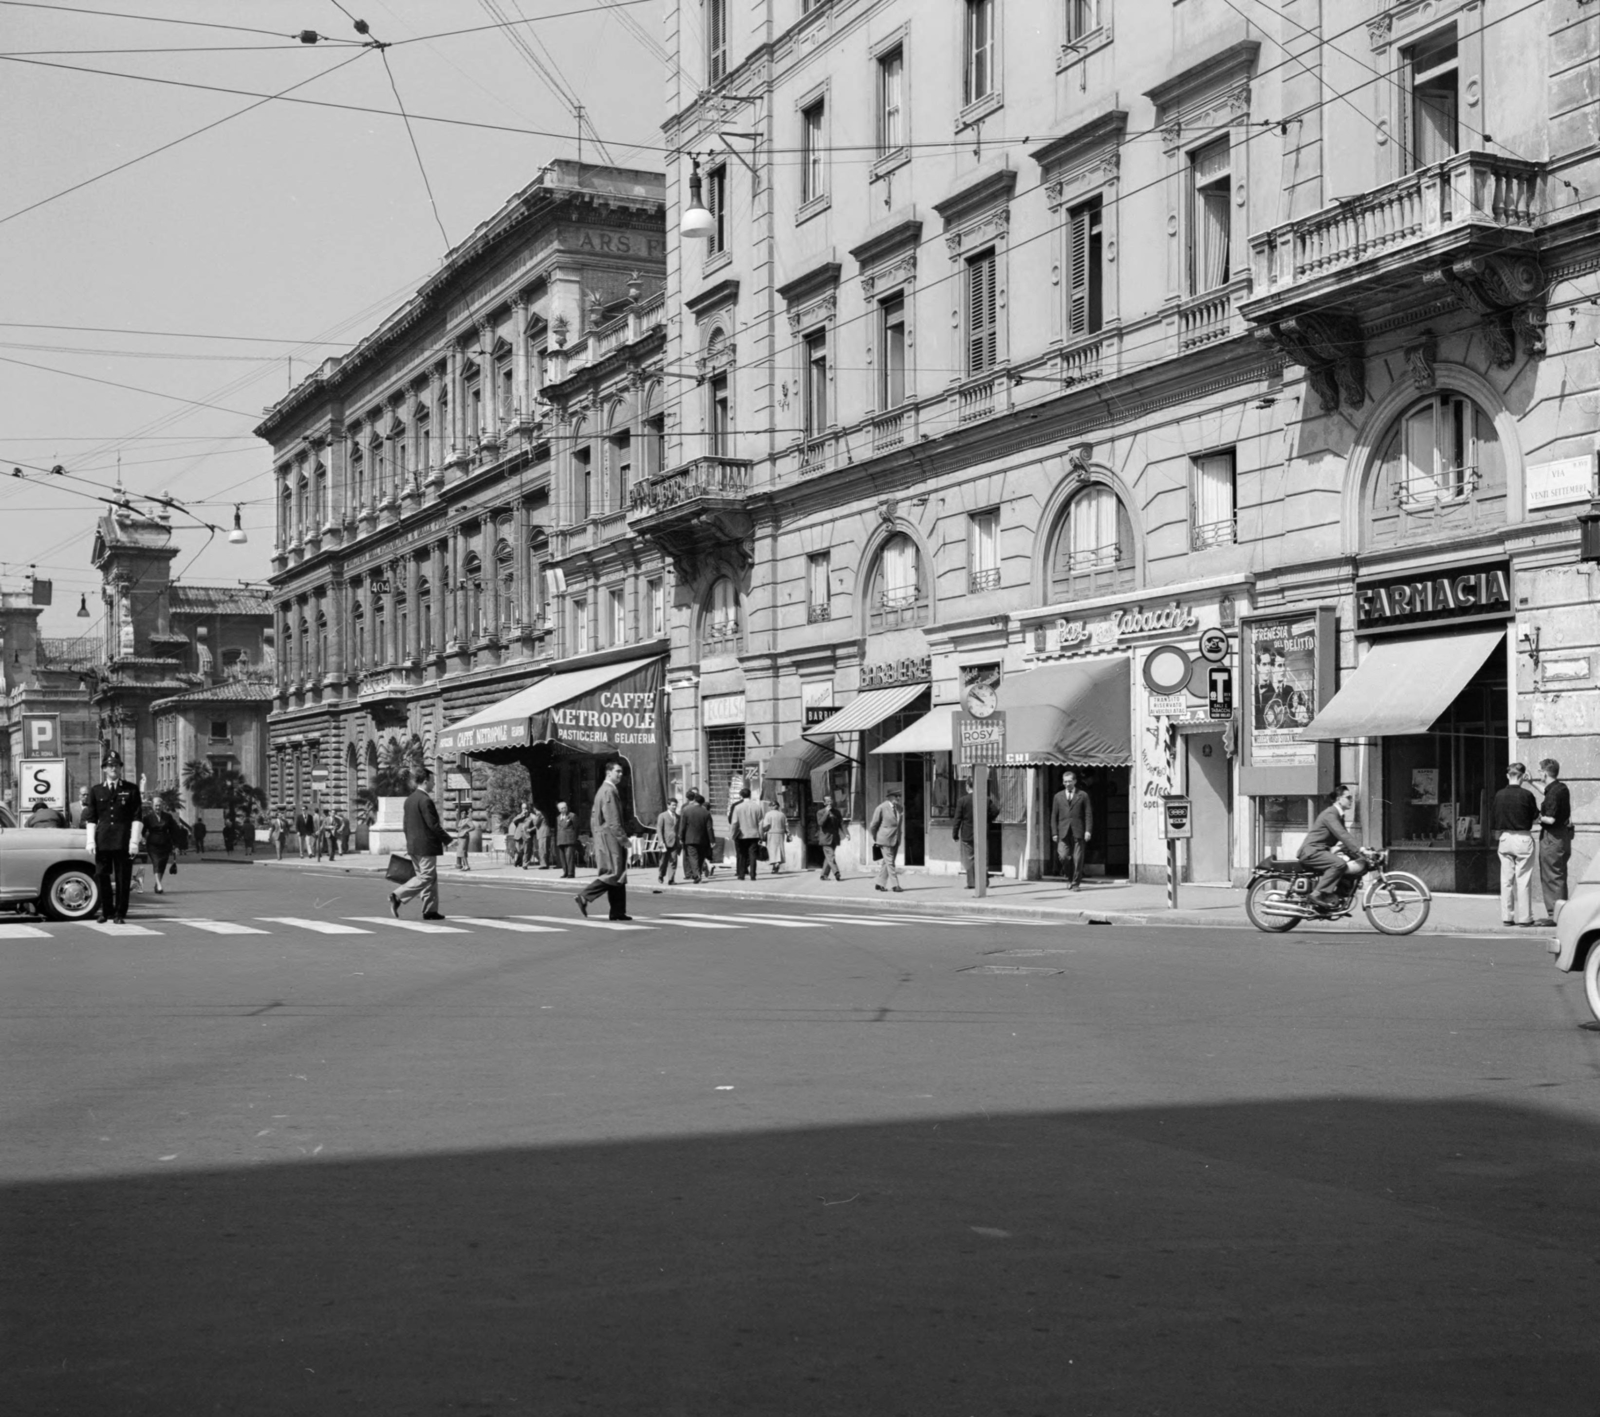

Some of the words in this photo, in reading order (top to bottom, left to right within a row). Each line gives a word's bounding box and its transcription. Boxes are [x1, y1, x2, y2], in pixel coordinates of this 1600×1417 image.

[579, 230, 631, 254] ARS
[1551, 469, 1565, 478] VIA
[1530, 490, 1549, 500] VENTI
[1551, 484, 1587, 497] SETTEMBRE
[371, 582, 390, 593] 404
[1355, 570, 1509, 620] FARMACIA
[1111, 602, 1196, 638] Tabacchi
[1255, 625, 1288, 641] FRENESIA
[1283, 636, 1314, 652] DELITTO
[550, 708, 655, 729] METROPOLE
[31, 720, 53, 750] P
[558, 729, 608, 743] PASTICCERIA
[614, 732, 656, 744] GELATERIA
[963, 729, 994, 741] ROSY
